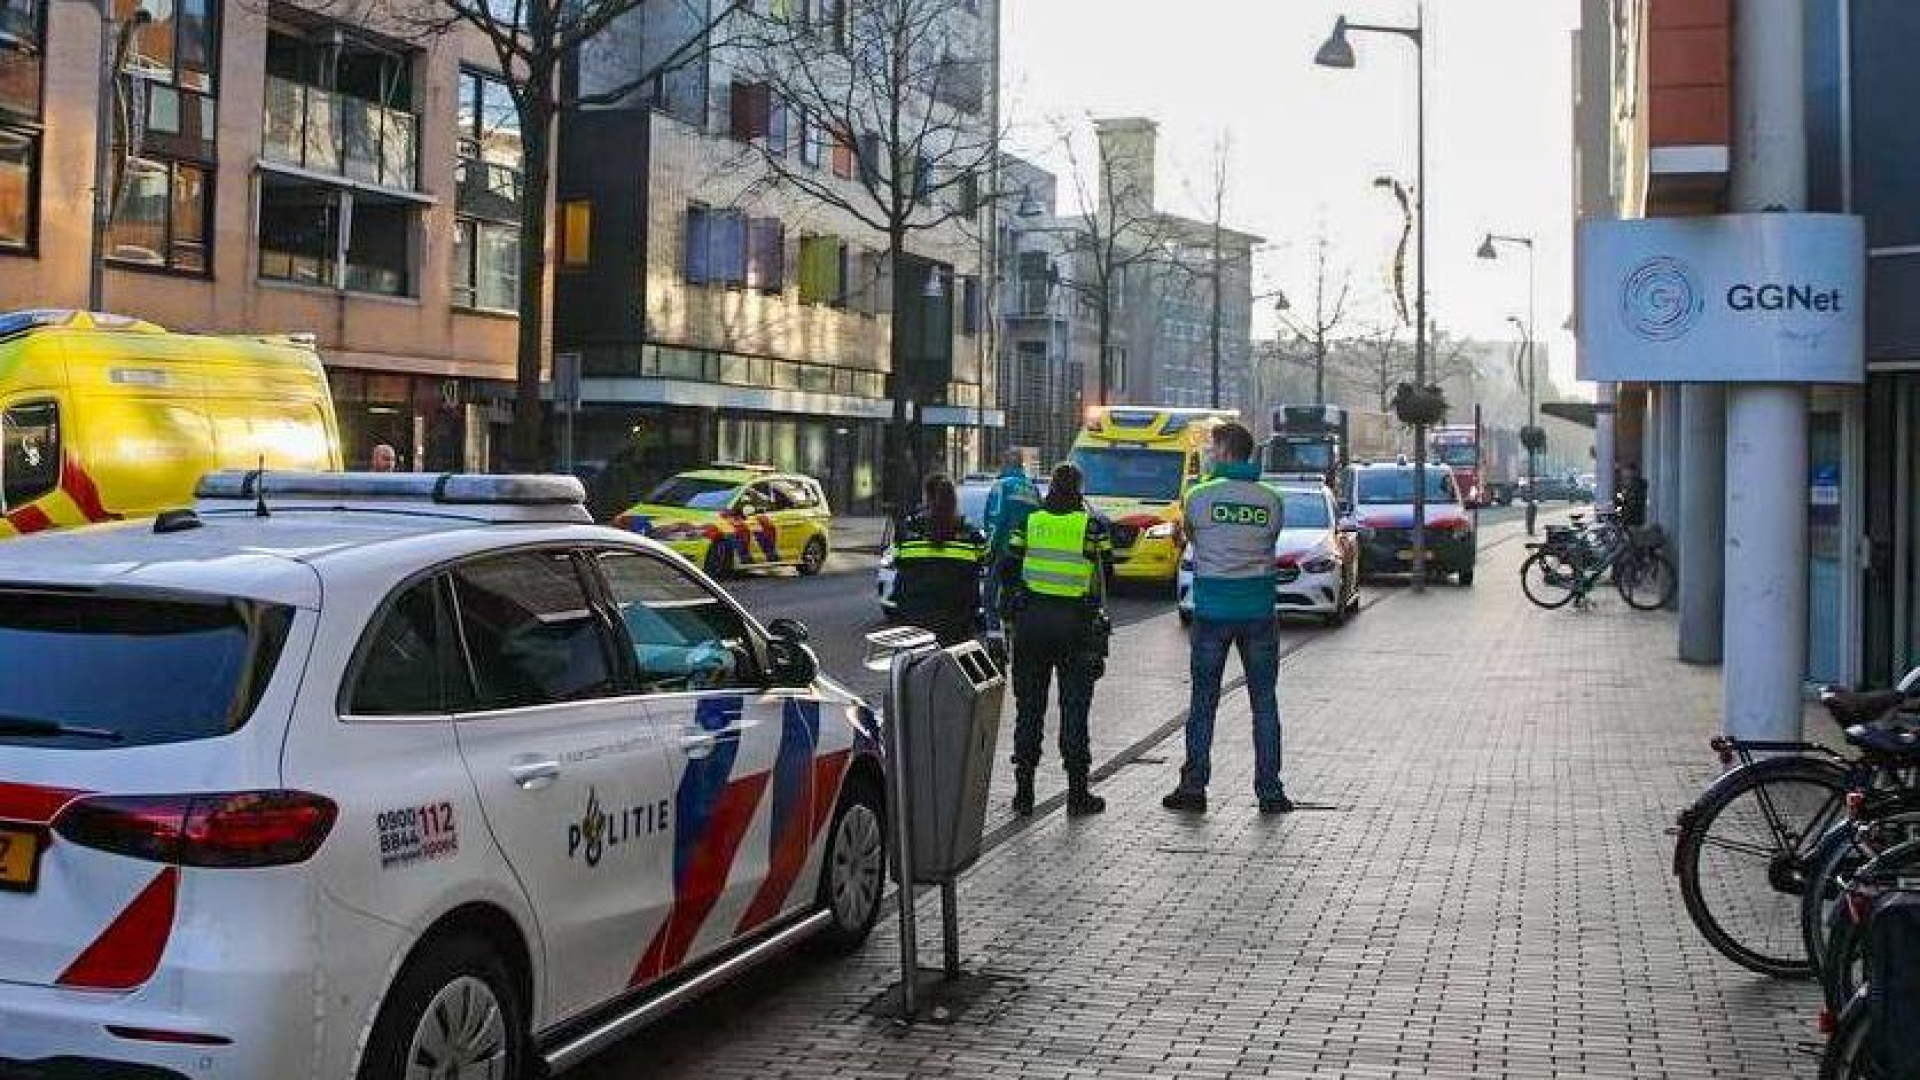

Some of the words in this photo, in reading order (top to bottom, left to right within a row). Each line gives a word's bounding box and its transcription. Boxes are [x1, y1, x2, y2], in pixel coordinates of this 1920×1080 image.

[1726, 284, 1842, 312] GGNet
[1212, 506, 1268, 523] OvDG
[377, 807, 416, 831] 0900
[419, 802, 455, 835] 112
[380, 831, 420, 854] 8844
